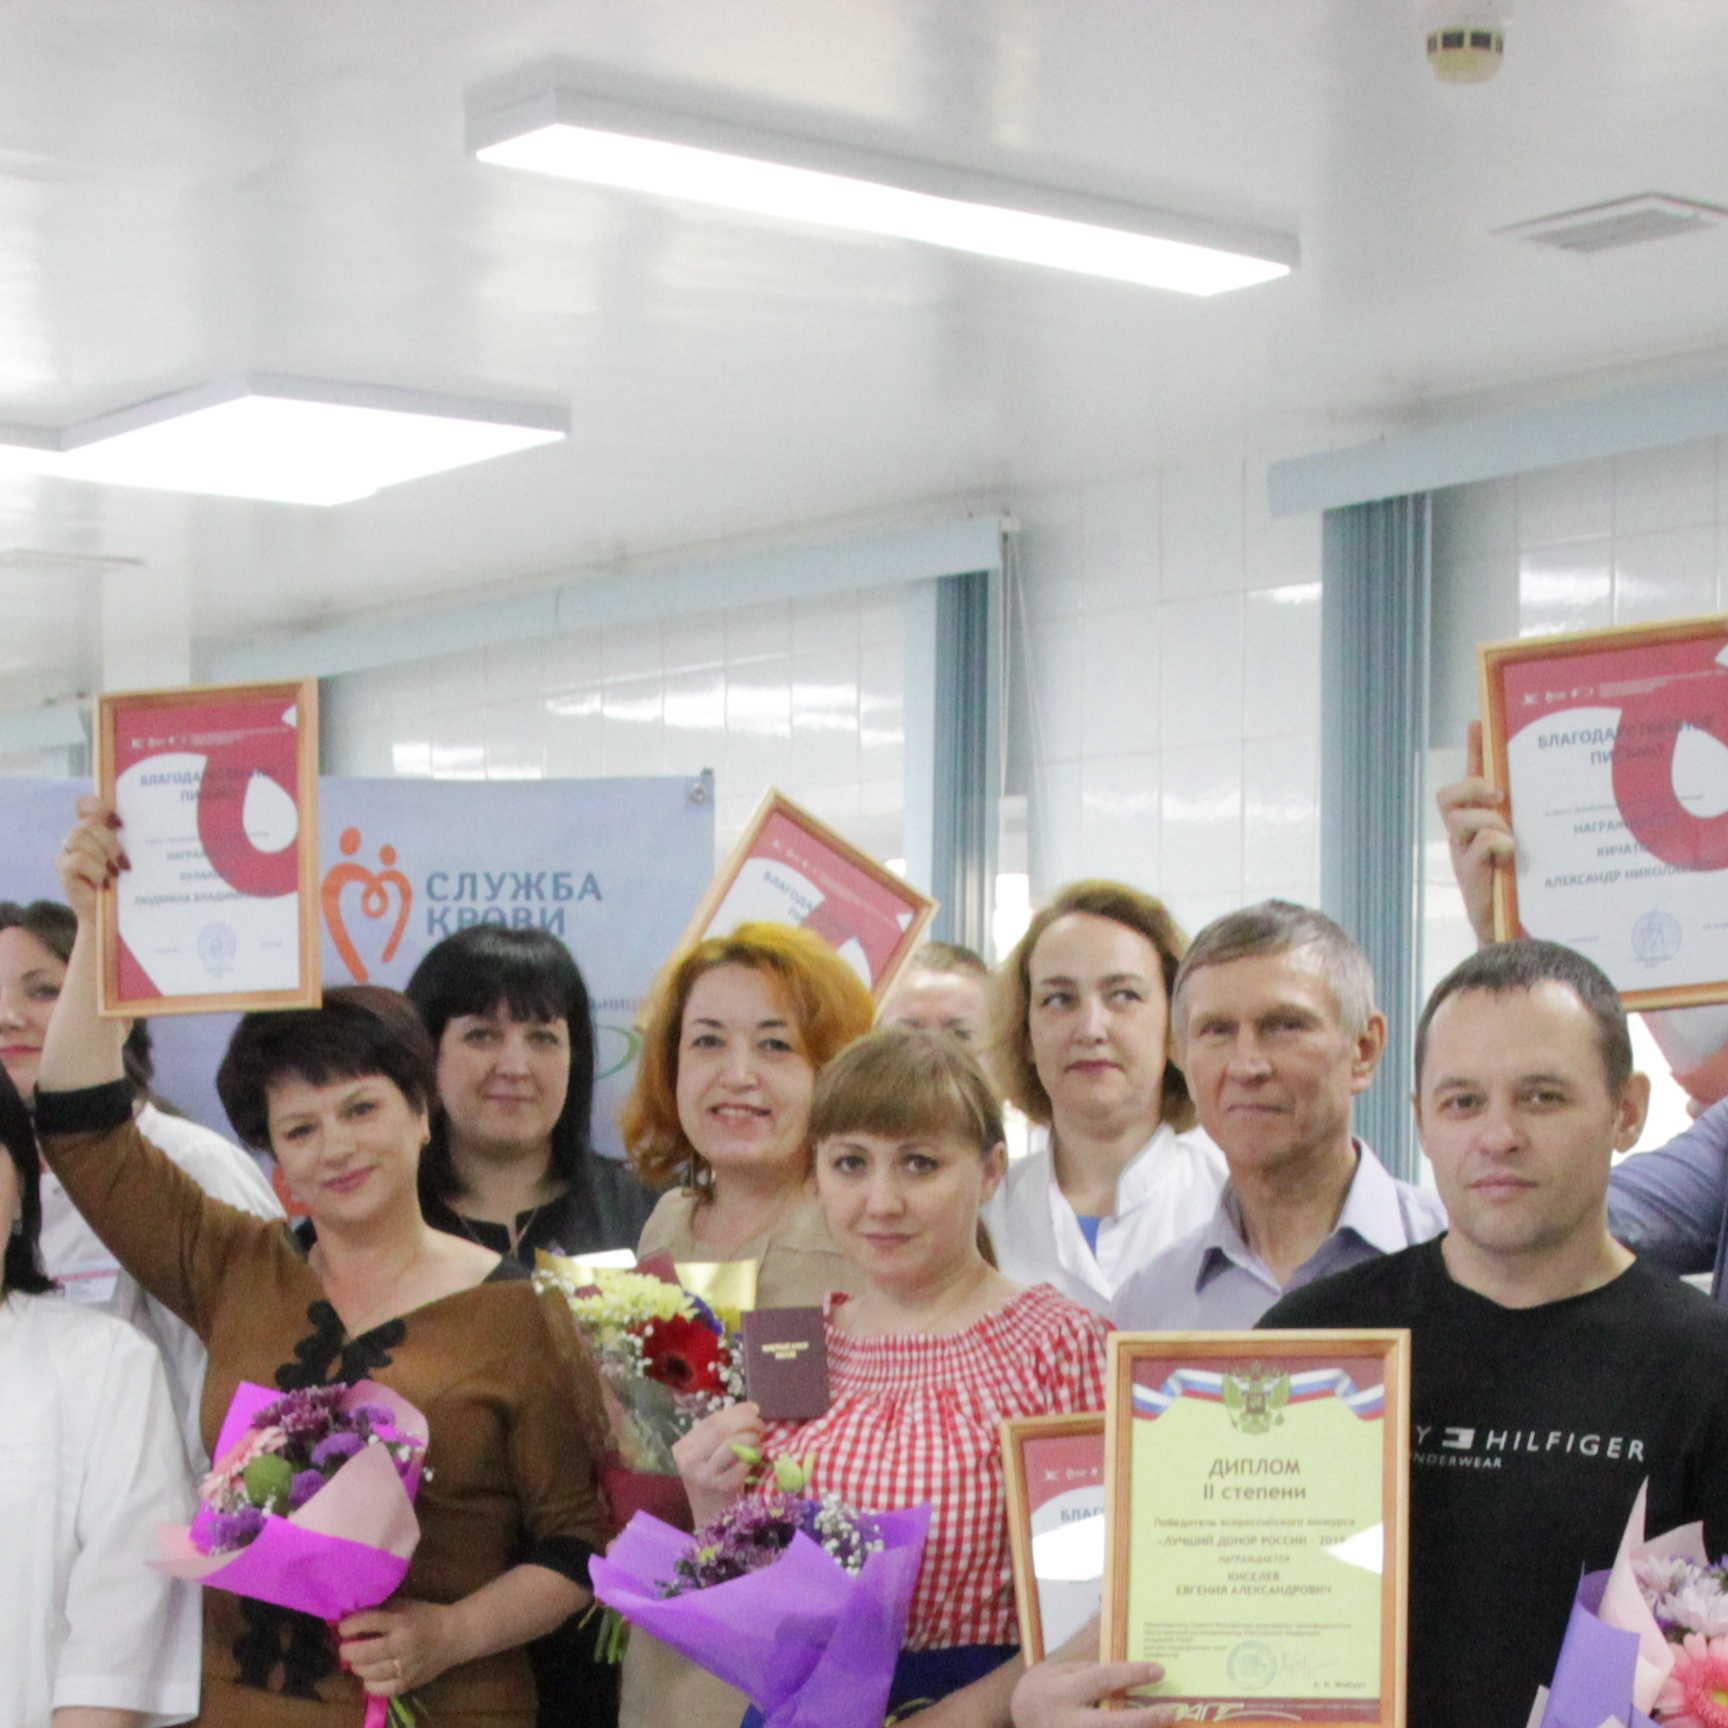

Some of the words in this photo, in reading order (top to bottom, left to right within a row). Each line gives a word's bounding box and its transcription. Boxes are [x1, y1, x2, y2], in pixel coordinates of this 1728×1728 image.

[1625, 861, 1718, 879] НИКОЛАЕ
[425, 871, 603, 901] СЛУЖБА
[427, 906, 565, 936] КРОВИ
[1485, 1429, 1646, 1462] HILFIGER
[1209, 1458, 1301, 1478] ДИПЛОМ
[1412, 1453, 1502, 1469] NDERWEAR
[1221, 1485, 1307, 1500] степени
